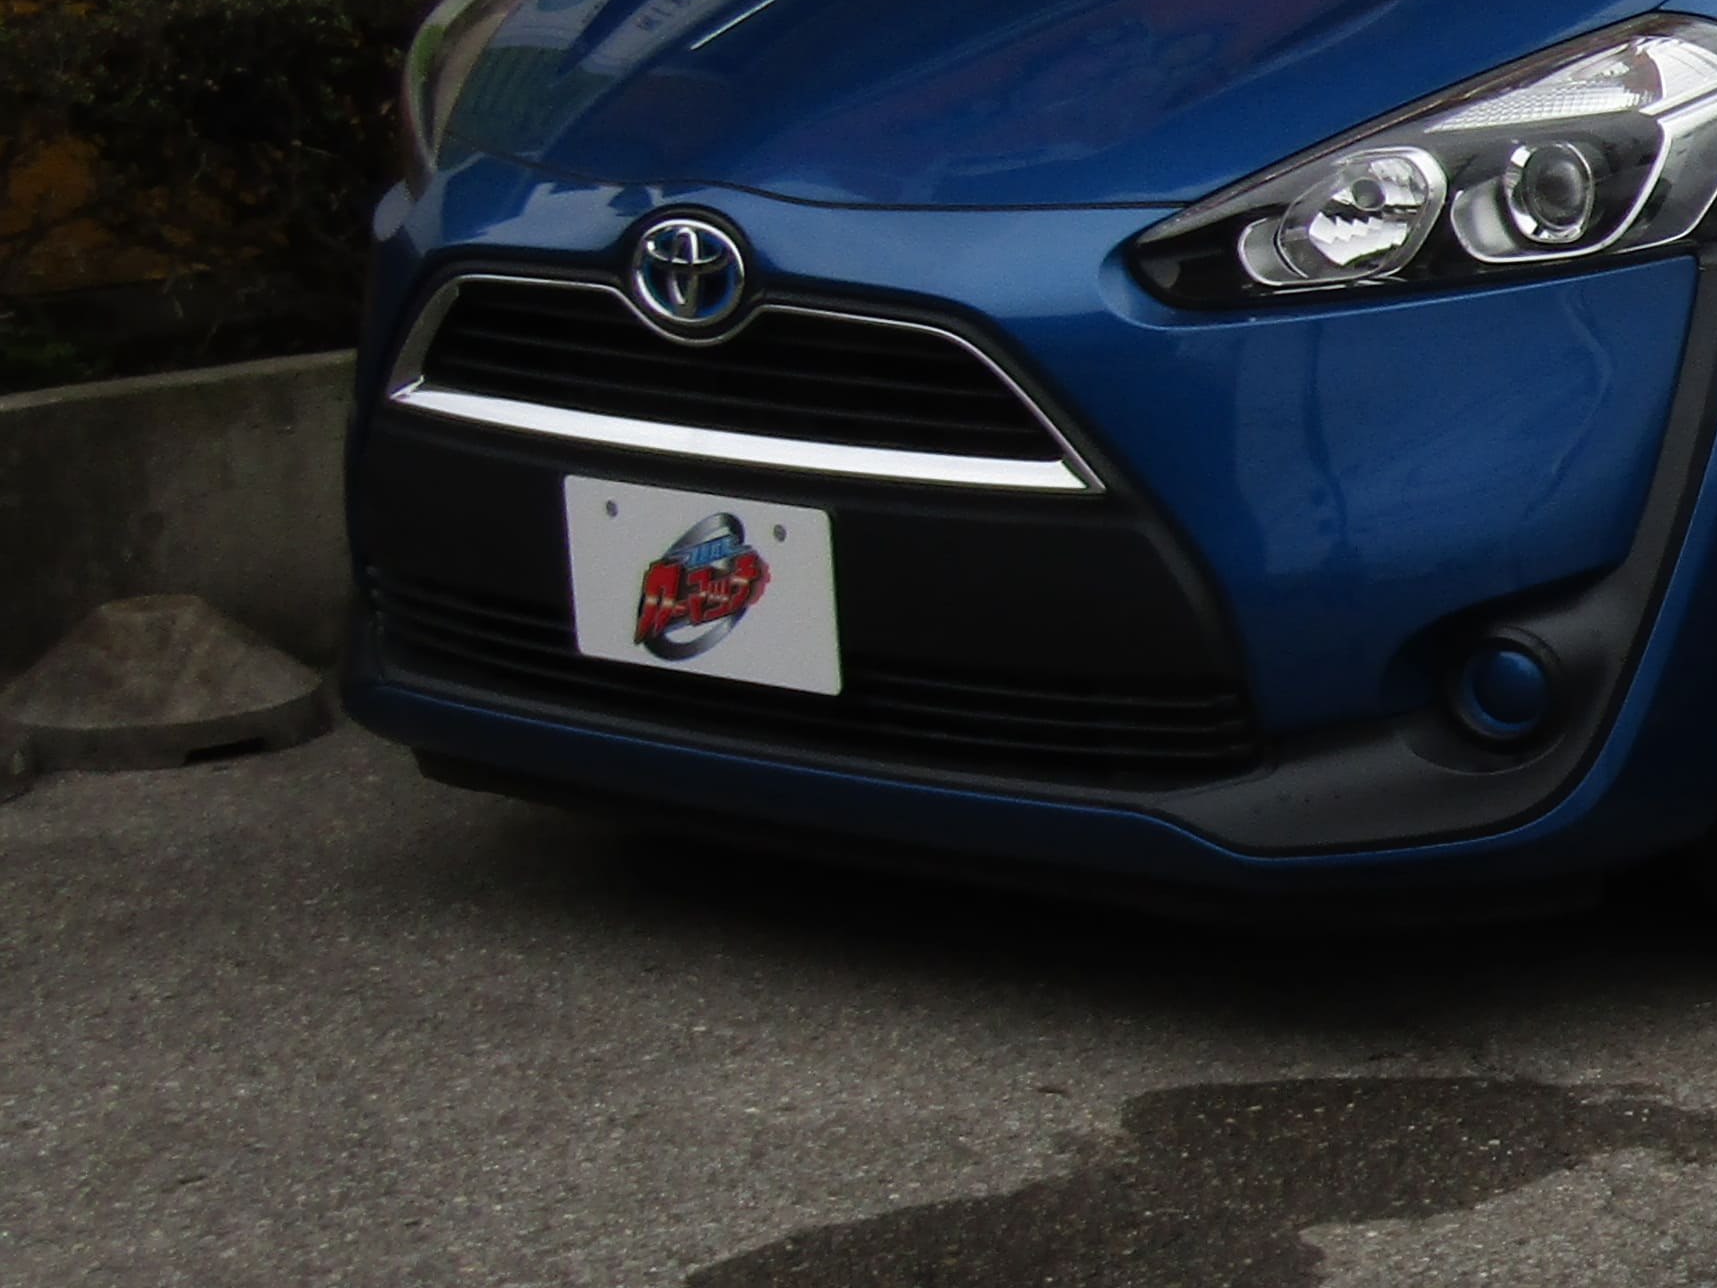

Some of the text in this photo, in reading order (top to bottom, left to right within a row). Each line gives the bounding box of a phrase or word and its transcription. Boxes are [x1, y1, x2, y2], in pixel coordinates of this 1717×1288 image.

[634, 550, 760, 646] カーマッチ
